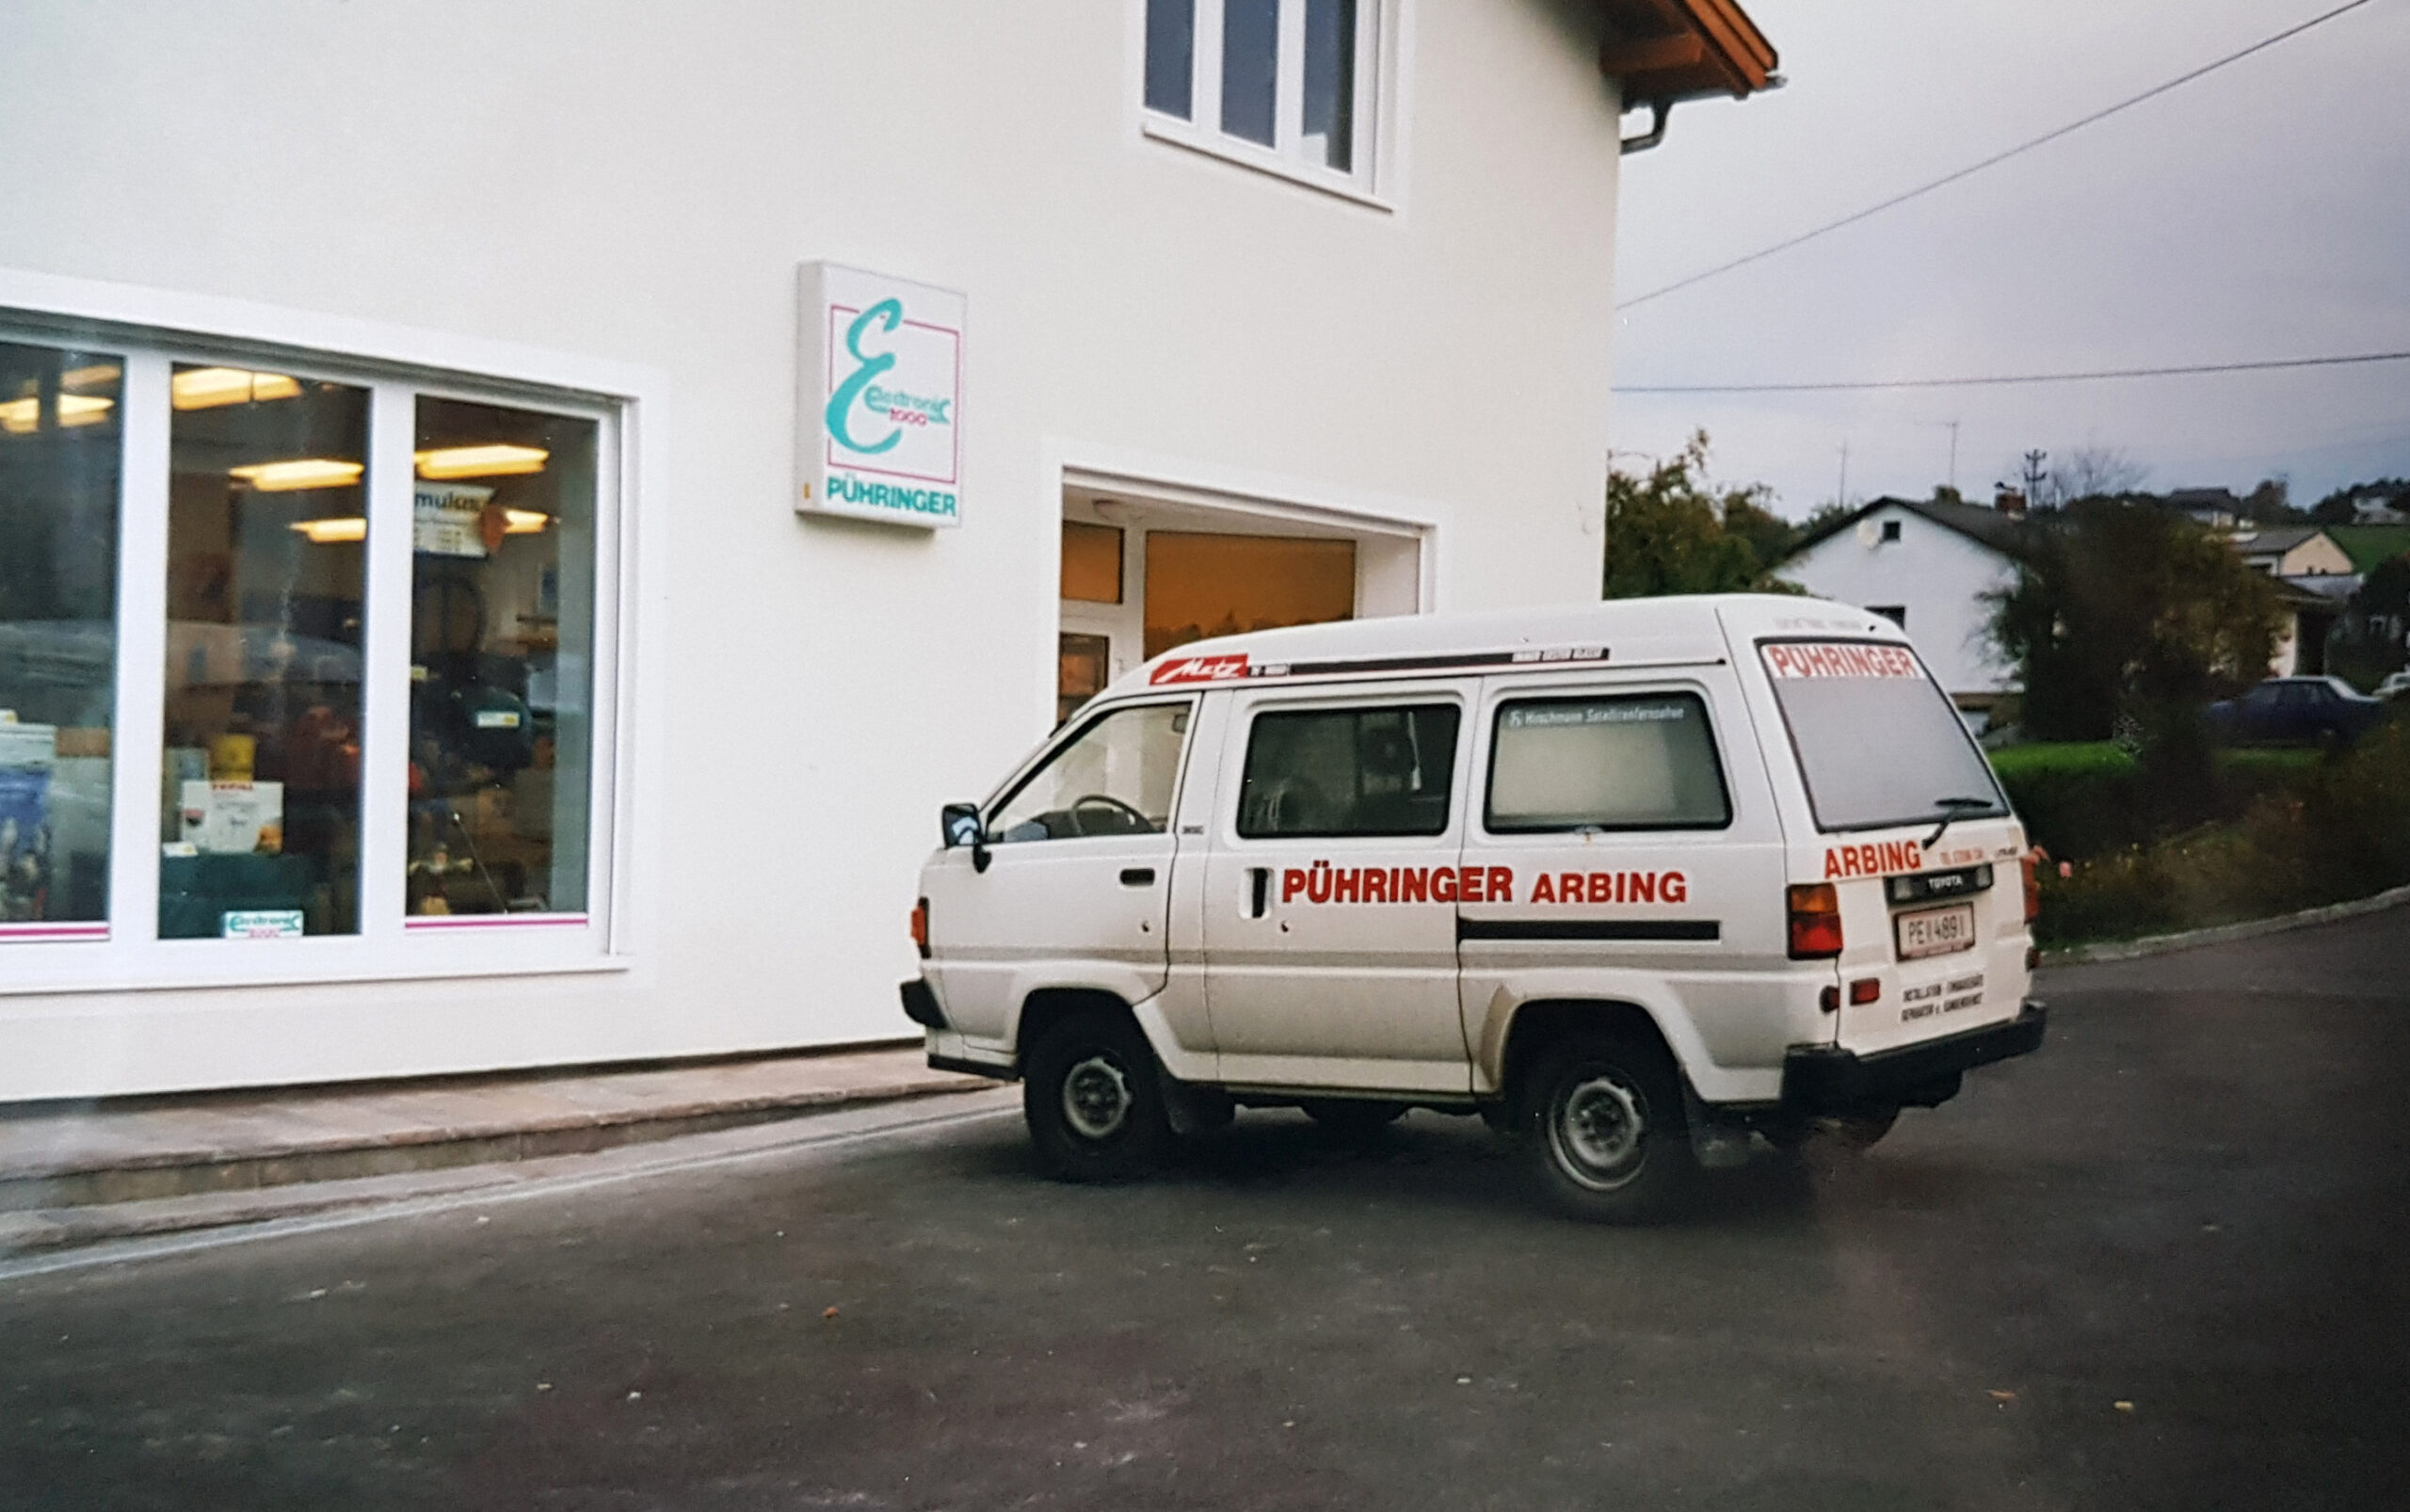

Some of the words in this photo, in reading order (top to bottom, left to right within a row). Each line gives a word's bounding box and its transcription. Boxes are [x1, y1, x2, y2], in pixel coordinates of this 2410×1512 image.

[827, 472, 956, 517] PÜHRINGER
[1154, 657, 1244, 684] Metz
[1824, 840, 1921, 879] ARBING
[1282, 861, 1514, 904] PÜHRINGER
[1530, 872, 1687, 904] ARBING
[1928, 875, 1964, 889] TOYOTA
